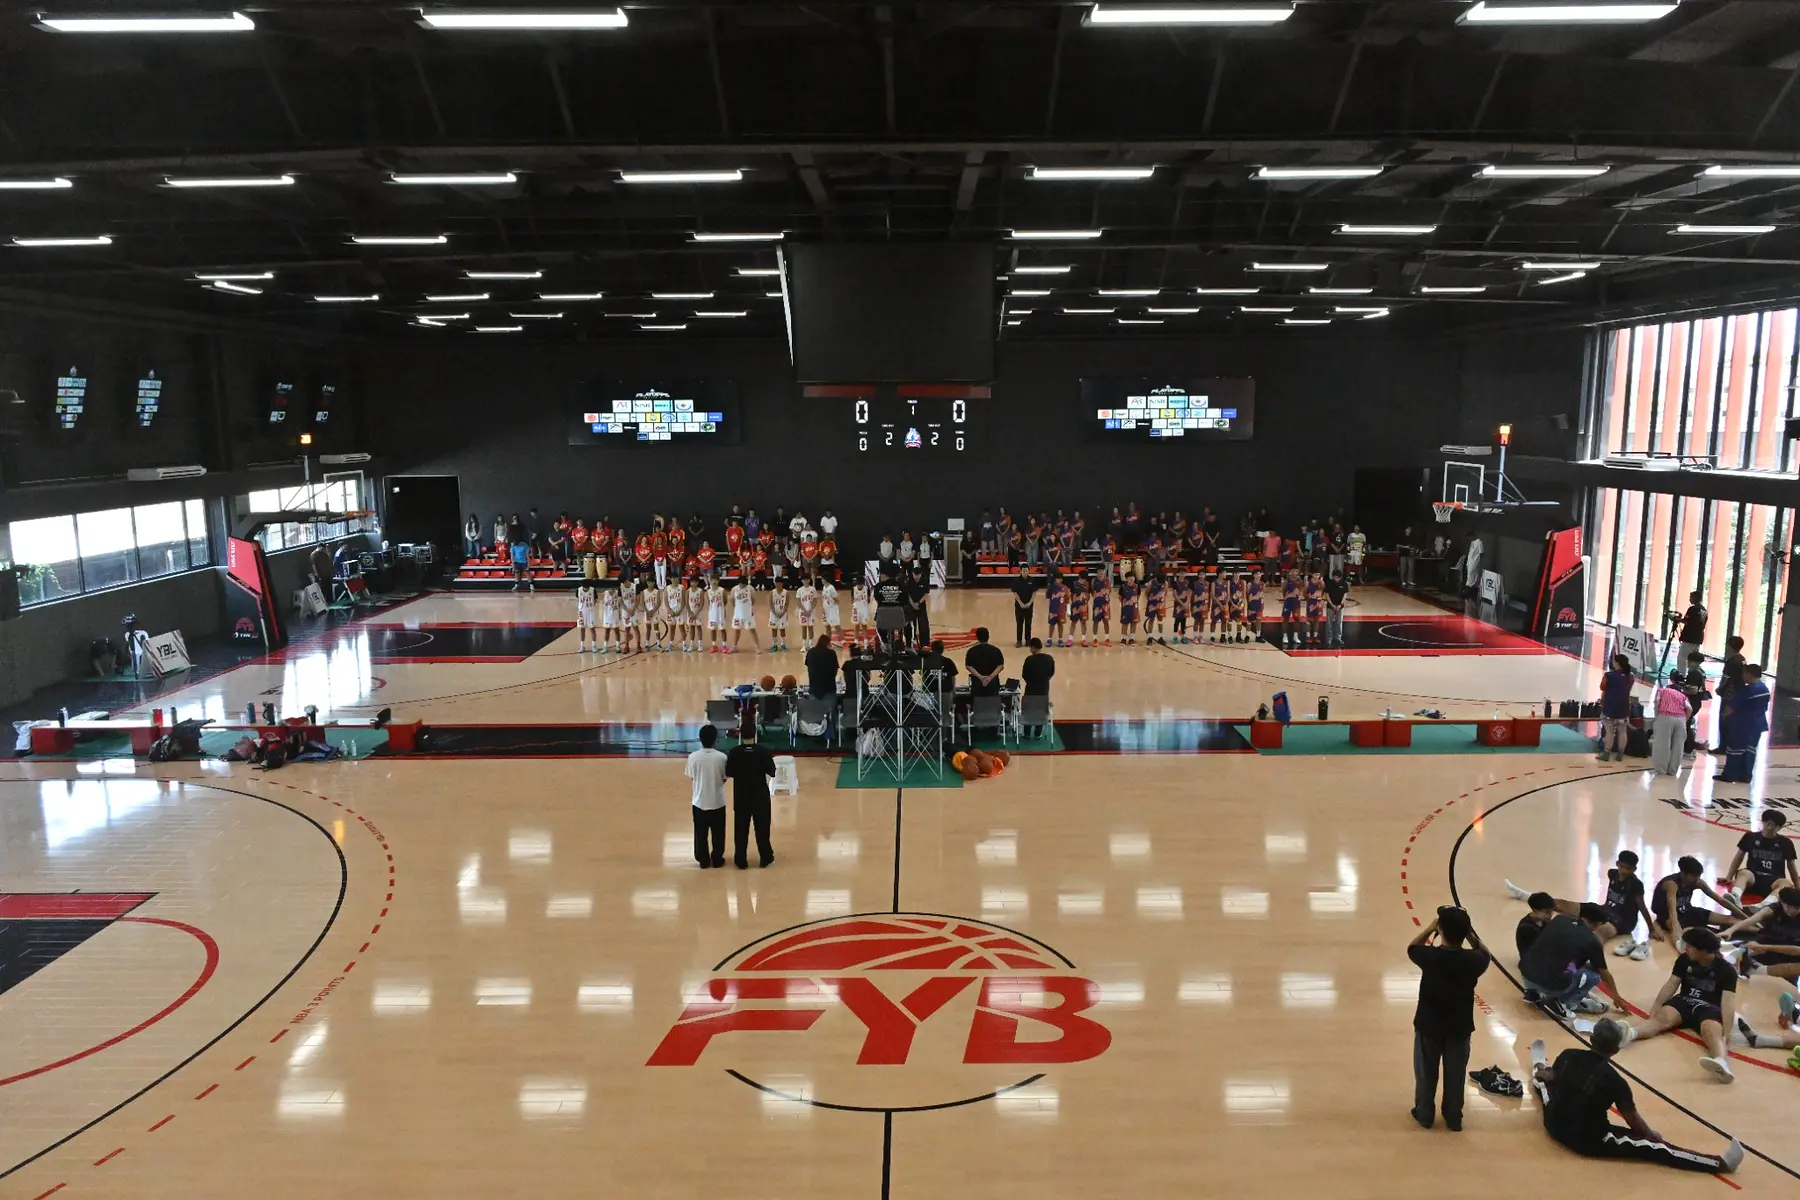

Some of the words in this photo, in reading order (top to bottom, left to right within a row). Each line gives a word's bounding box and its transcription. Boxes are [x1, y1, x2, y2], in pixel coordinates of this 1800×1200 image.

[855, 400, 868, 423] 0
[952, 399, 965, 423] 0
[859, 437, 867, 451] 0
[885, 431, 893, 446] 2
[930, 431, 939, 446] 2
[956, 437, 964, 451] 0
[156, 642, 177, 658] YBL
[1623, 635, 1640, 653] YBL
[313, 976, 345, 1002] POINTS
[645, 976, 1112, 1067] FYB
